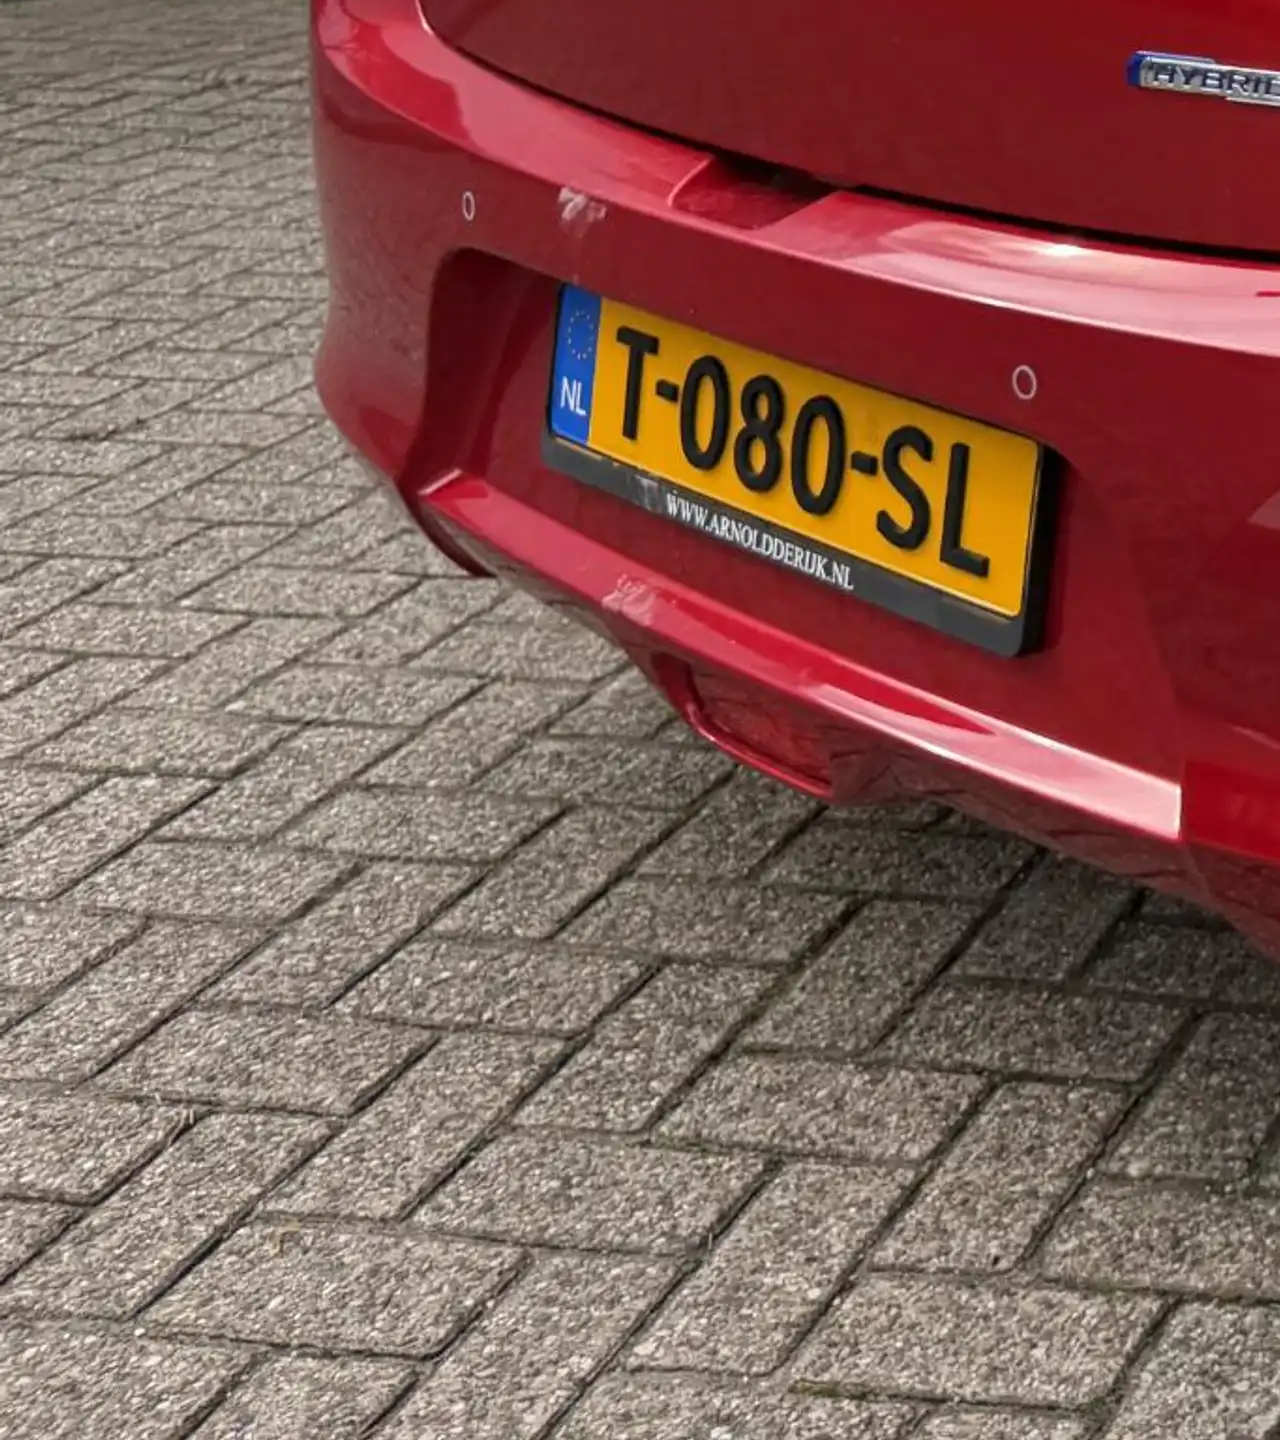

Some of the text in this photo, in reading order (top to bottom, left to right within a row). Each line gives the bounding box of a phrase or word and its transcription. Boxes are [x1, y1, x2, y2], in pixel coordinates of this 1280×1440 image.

[559, 375, 588, 418] NL
[615, 325, 991, 579] T-080-SL
[665, 489, 855, 592] WWW.ARNOLDDERIJK.NL
